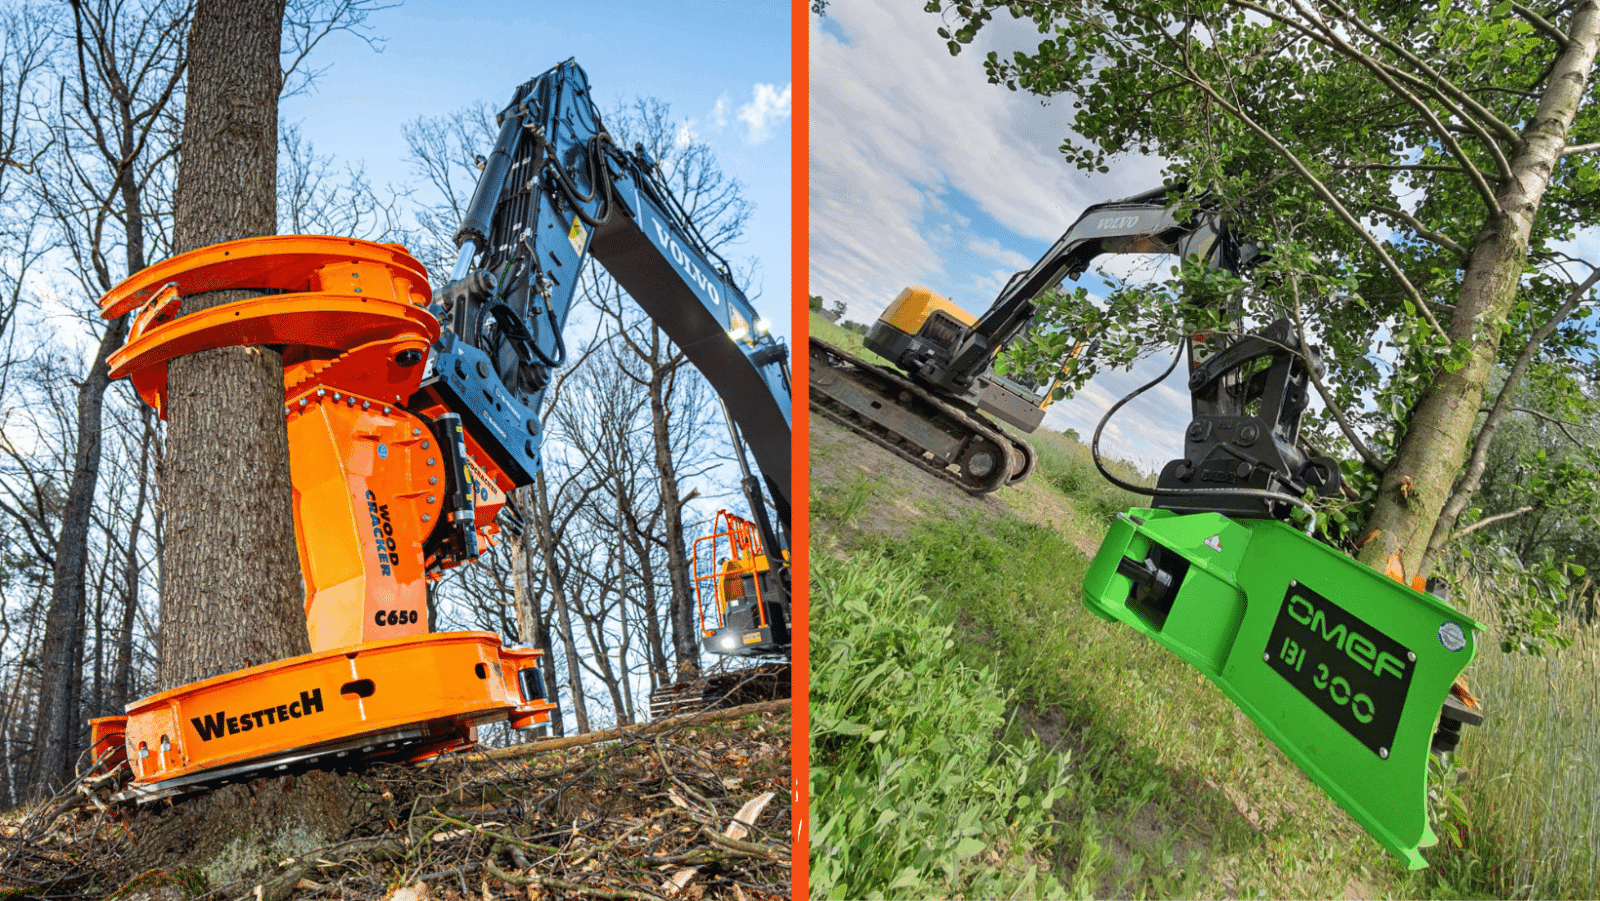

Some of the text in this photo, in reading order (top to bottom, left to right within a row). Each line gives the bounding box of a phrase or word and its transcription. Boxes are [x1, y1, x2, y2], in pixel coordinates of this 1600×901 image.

[1097, 216, 1139, 229] VOLVO
[652, 217, 719, 305] VOLVO
[366, 490, 391, 576] CRACKER
[379, 504, 399, 566] WOOD
[374, 610, 418, 626] C650
[1280, 636, 1375, 723] BI 300
